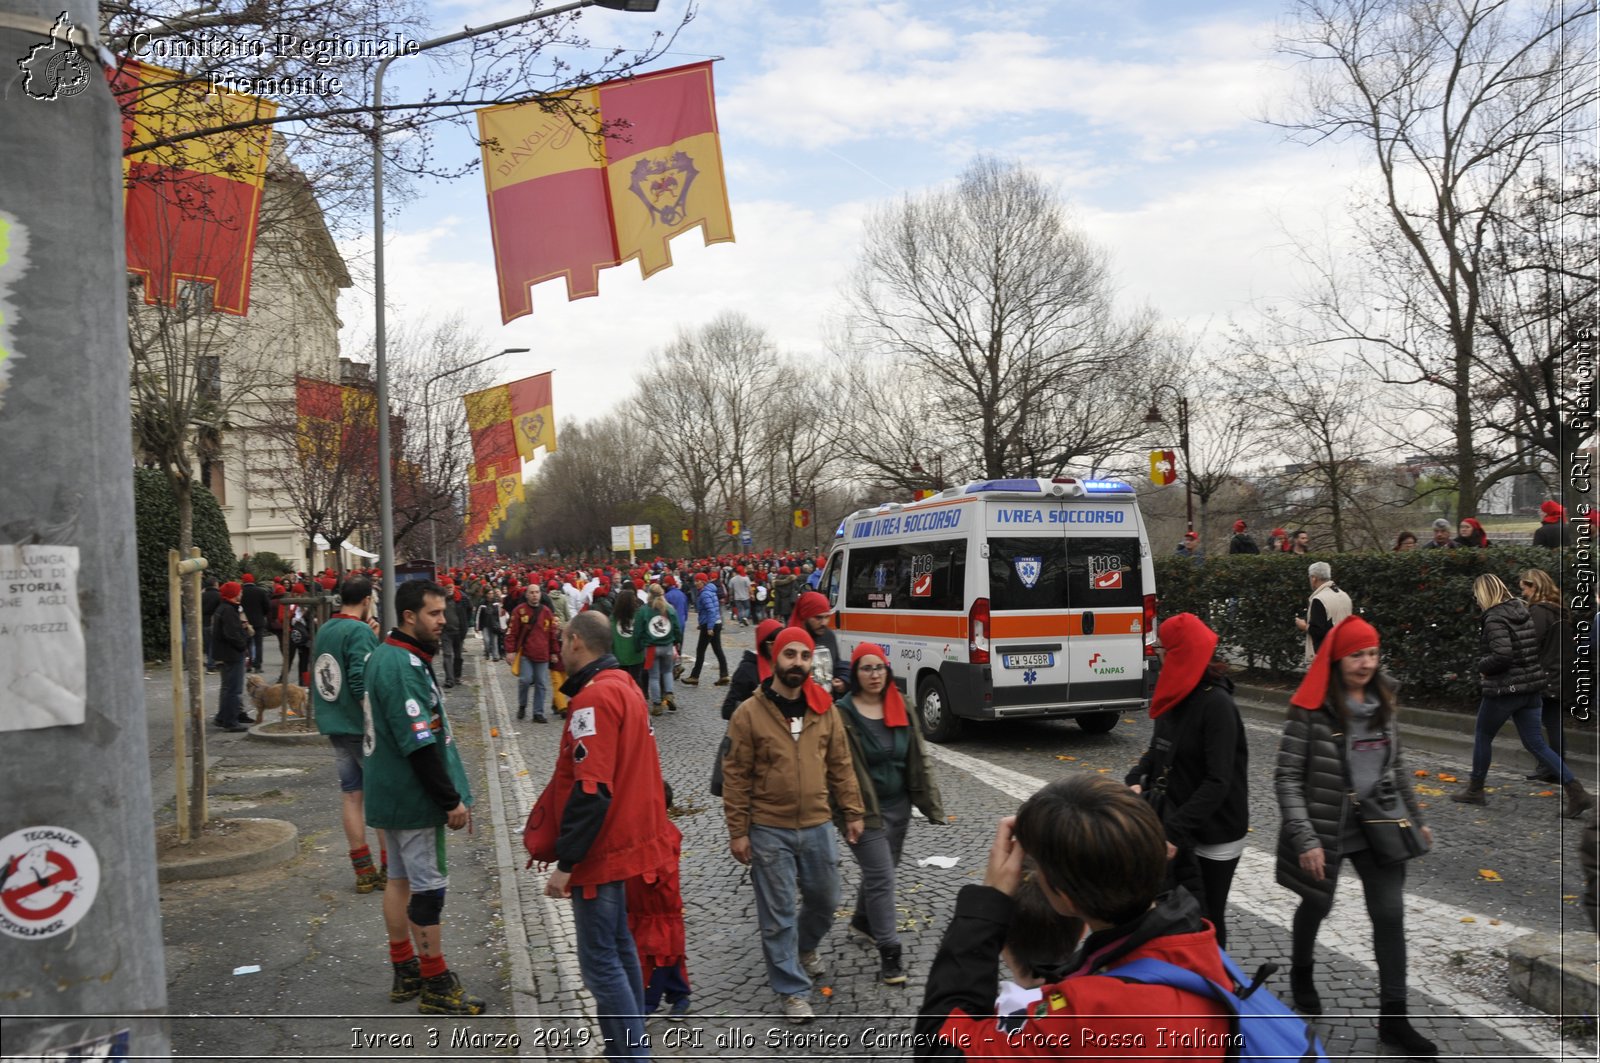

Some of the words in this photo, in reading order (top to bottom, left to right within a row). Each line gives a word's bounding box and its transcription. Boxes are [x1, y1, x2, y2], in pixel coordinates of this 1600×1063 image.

[997, 510, 1043, 523] IVREA
[1048, 510, 1124, 523] SOCCORSO
[871, 517, 902, 537] IVREA
[903, 508, 962, 533] SOCCORSO
[913, 554, 933, 574] 118
[1092, 555, 1121, 571] 118
[52, 568, 66, 578] DI
[38, 595, 67, 605] AGLI
[23, 622, 68, 633] PREZZI
[1009, 655, 1020, 666] EW
[1099, 667, 1125, 675] ANPAS
